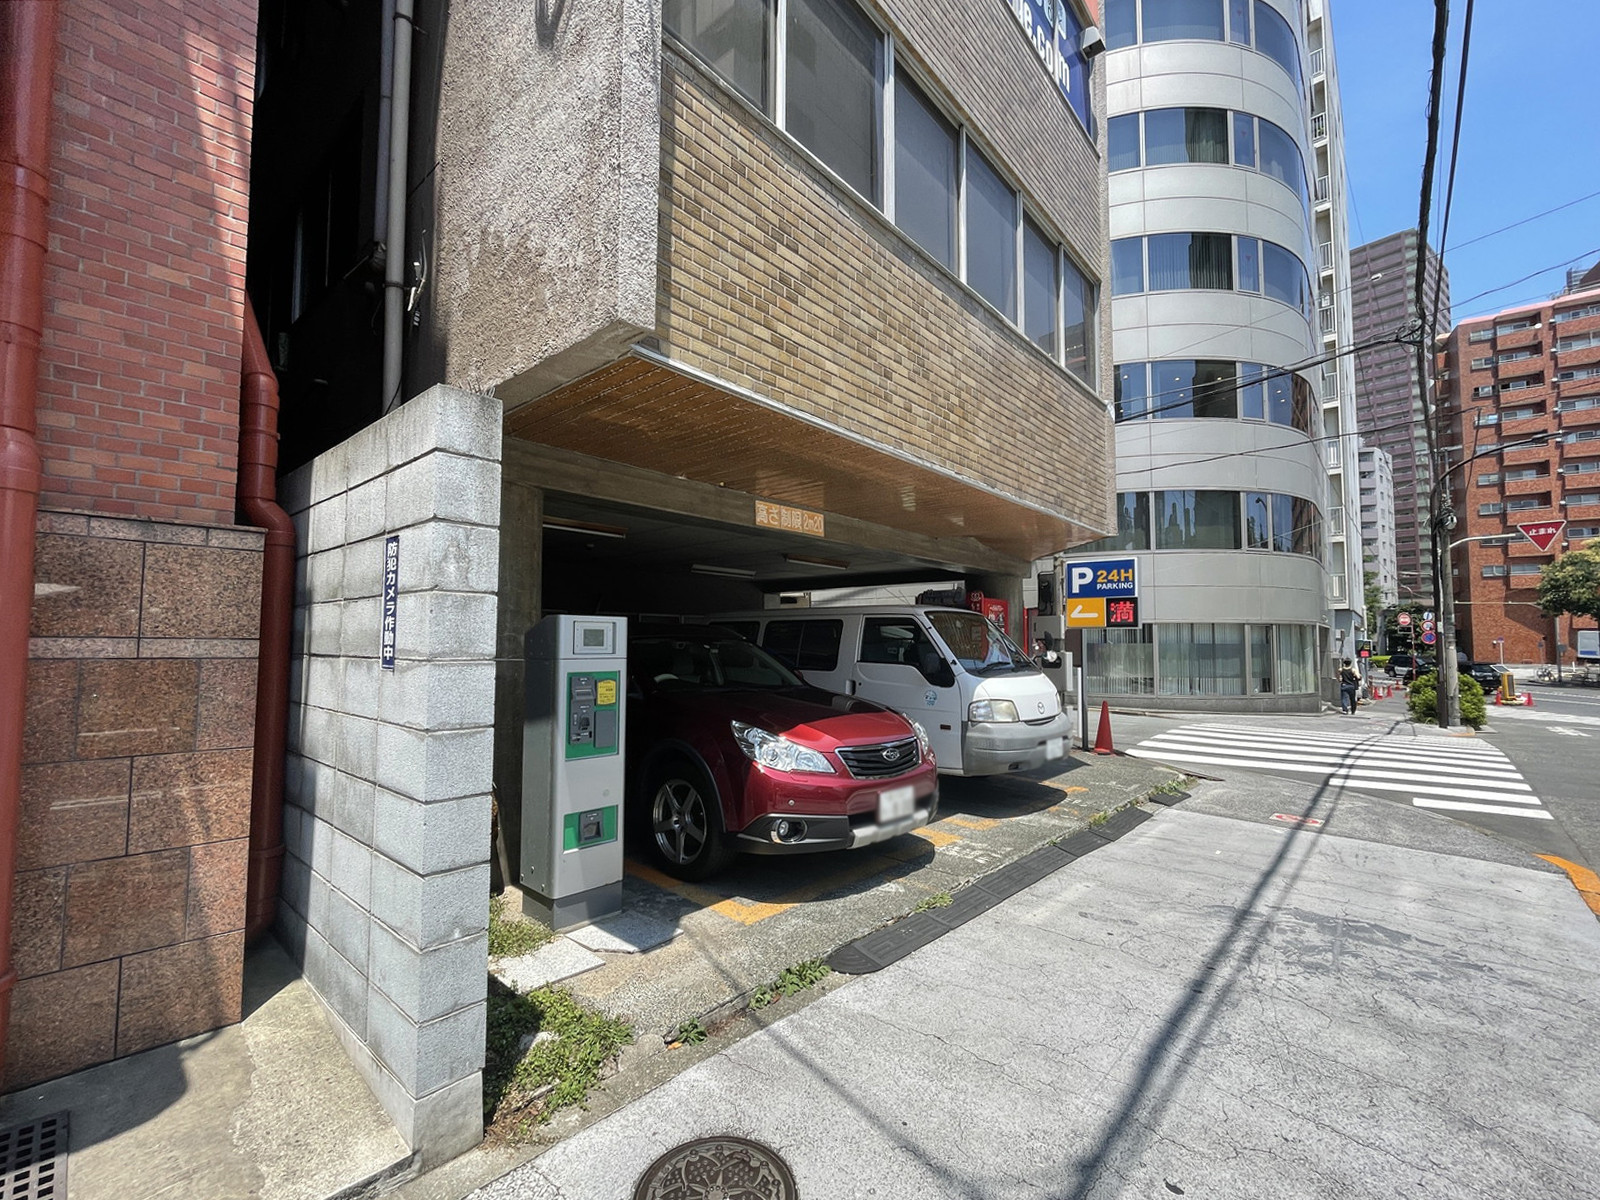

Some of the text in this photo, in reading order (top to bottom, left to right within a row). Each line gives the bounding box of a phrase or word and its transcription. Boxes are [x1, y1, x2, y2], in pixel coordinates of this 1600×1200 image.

[1528, 526, 1557, 537] 止まれ
[1072, 566, 1094, 594] P
[1096, 568, 1133, 583] 24H
[1096, 581, 1134, 590] PARKING
[383, 541, 398, 660] 防犯カメラ作動中
[1110, 601, 1135, 622] 満
